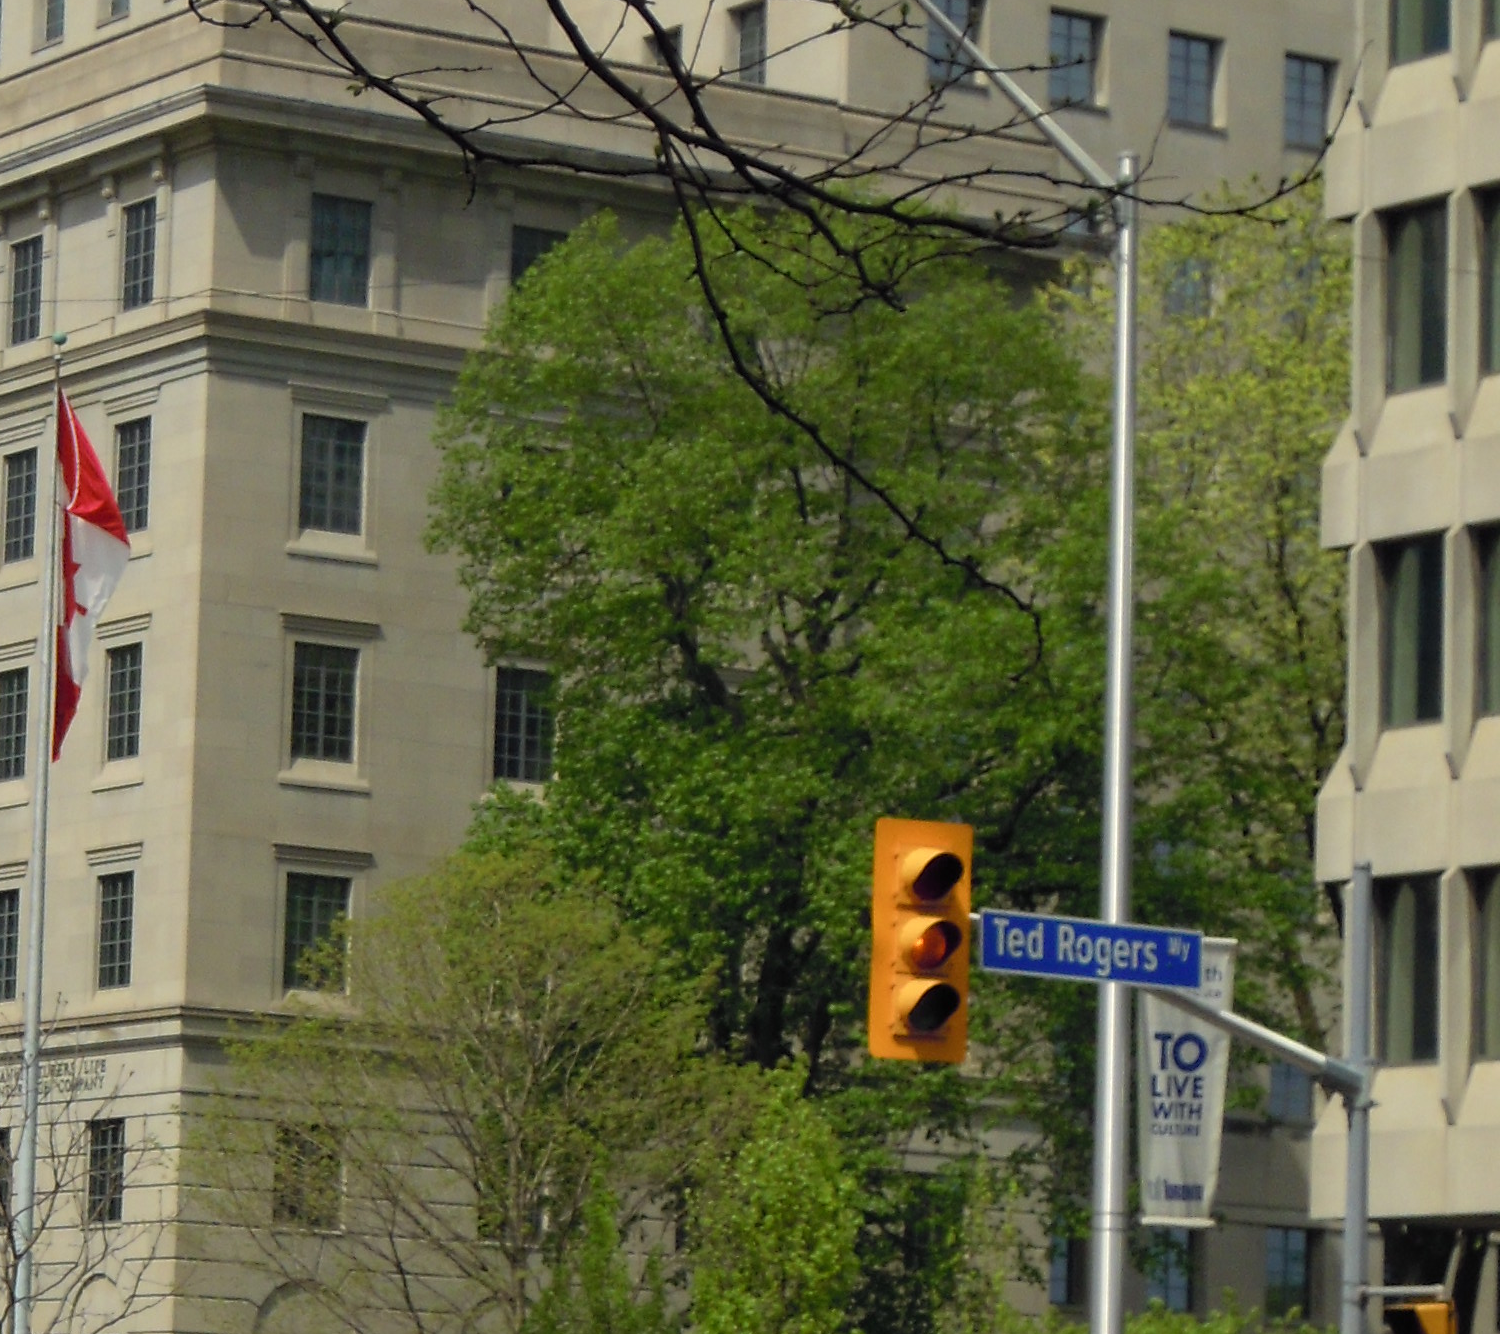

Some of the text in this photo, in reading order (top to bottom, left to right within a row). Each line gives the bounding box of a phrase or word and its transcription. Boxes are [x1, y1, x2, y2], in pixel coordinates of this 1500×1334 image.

[993, 917, 1190, 977] Ted Rogers Wy
[1154, 1033, 1208, 1072] TO
[84, 1058, 106, 1075] LIFE
[1150, 1075, 1204, 1098] LIVE
[1151, 1102, 1203, 1121] WITH
